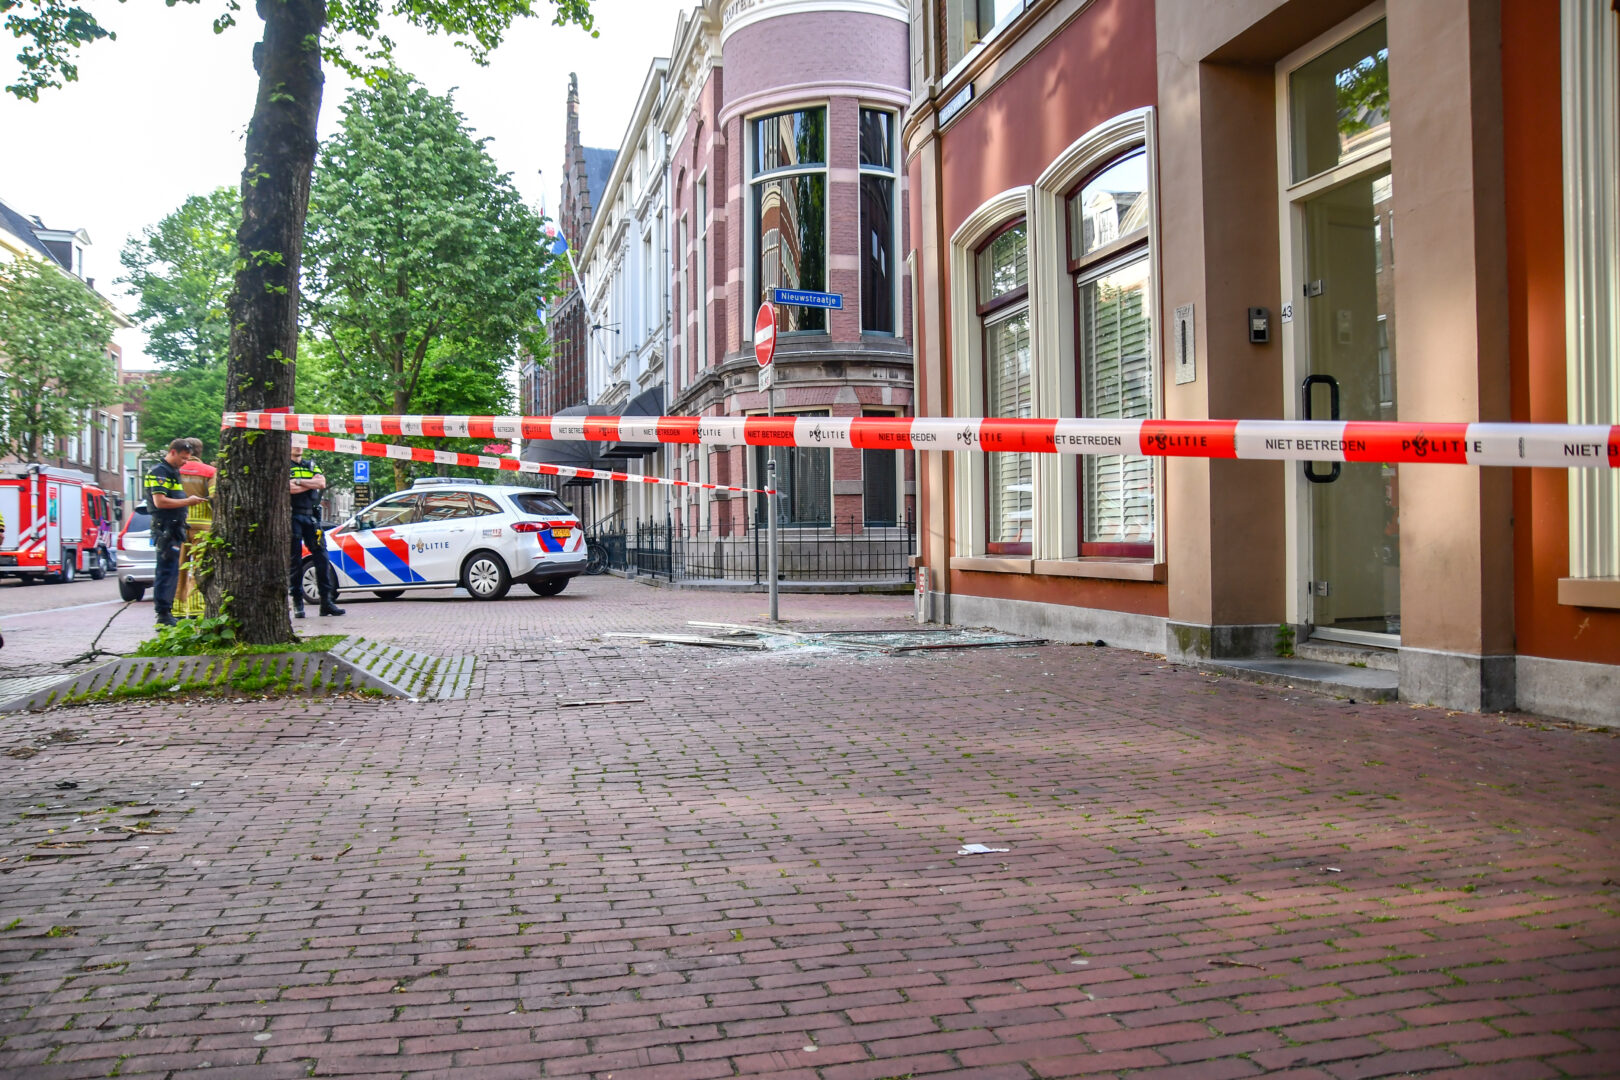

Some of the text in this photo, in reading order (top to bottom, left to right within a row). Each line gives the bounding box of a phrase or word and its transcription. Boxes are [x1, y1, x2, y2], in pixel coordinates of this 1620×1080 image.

[781, 291, 836, 306] Nieuwstraatje
[1281, 305, 1293, 319] 43
[643, 428, 654, 436] NIET
[654, 428, 681, 436] BETREDEN
[692, 425, 721, 439] POLITIE
[747, 430, 761, 439] NIET
[761, 430, 794, 439] BETREDEN
[809, 425, 845, 442] POLITIE
[878, 432, 894, 441] NIET
[896, 432, 937, 442] BETREDEN
[957, 427, 1003, 445] POLITIE
[1046, 435, 1067, 445] NIET
[1069, 435, 1121, 446] BETREDEN
[1147, 432, 1208, 450] POLITIE
[1265, 439, 1292, 450] NIET
[1296, 439, 1366, 451] BETREDEN
[1402, 433, 1482, 457] POLITIE
[1564, 444, 1602, 457] NIET
[357, 463, 366, 474] P
[411, 540, 449, 553] POLITIE
